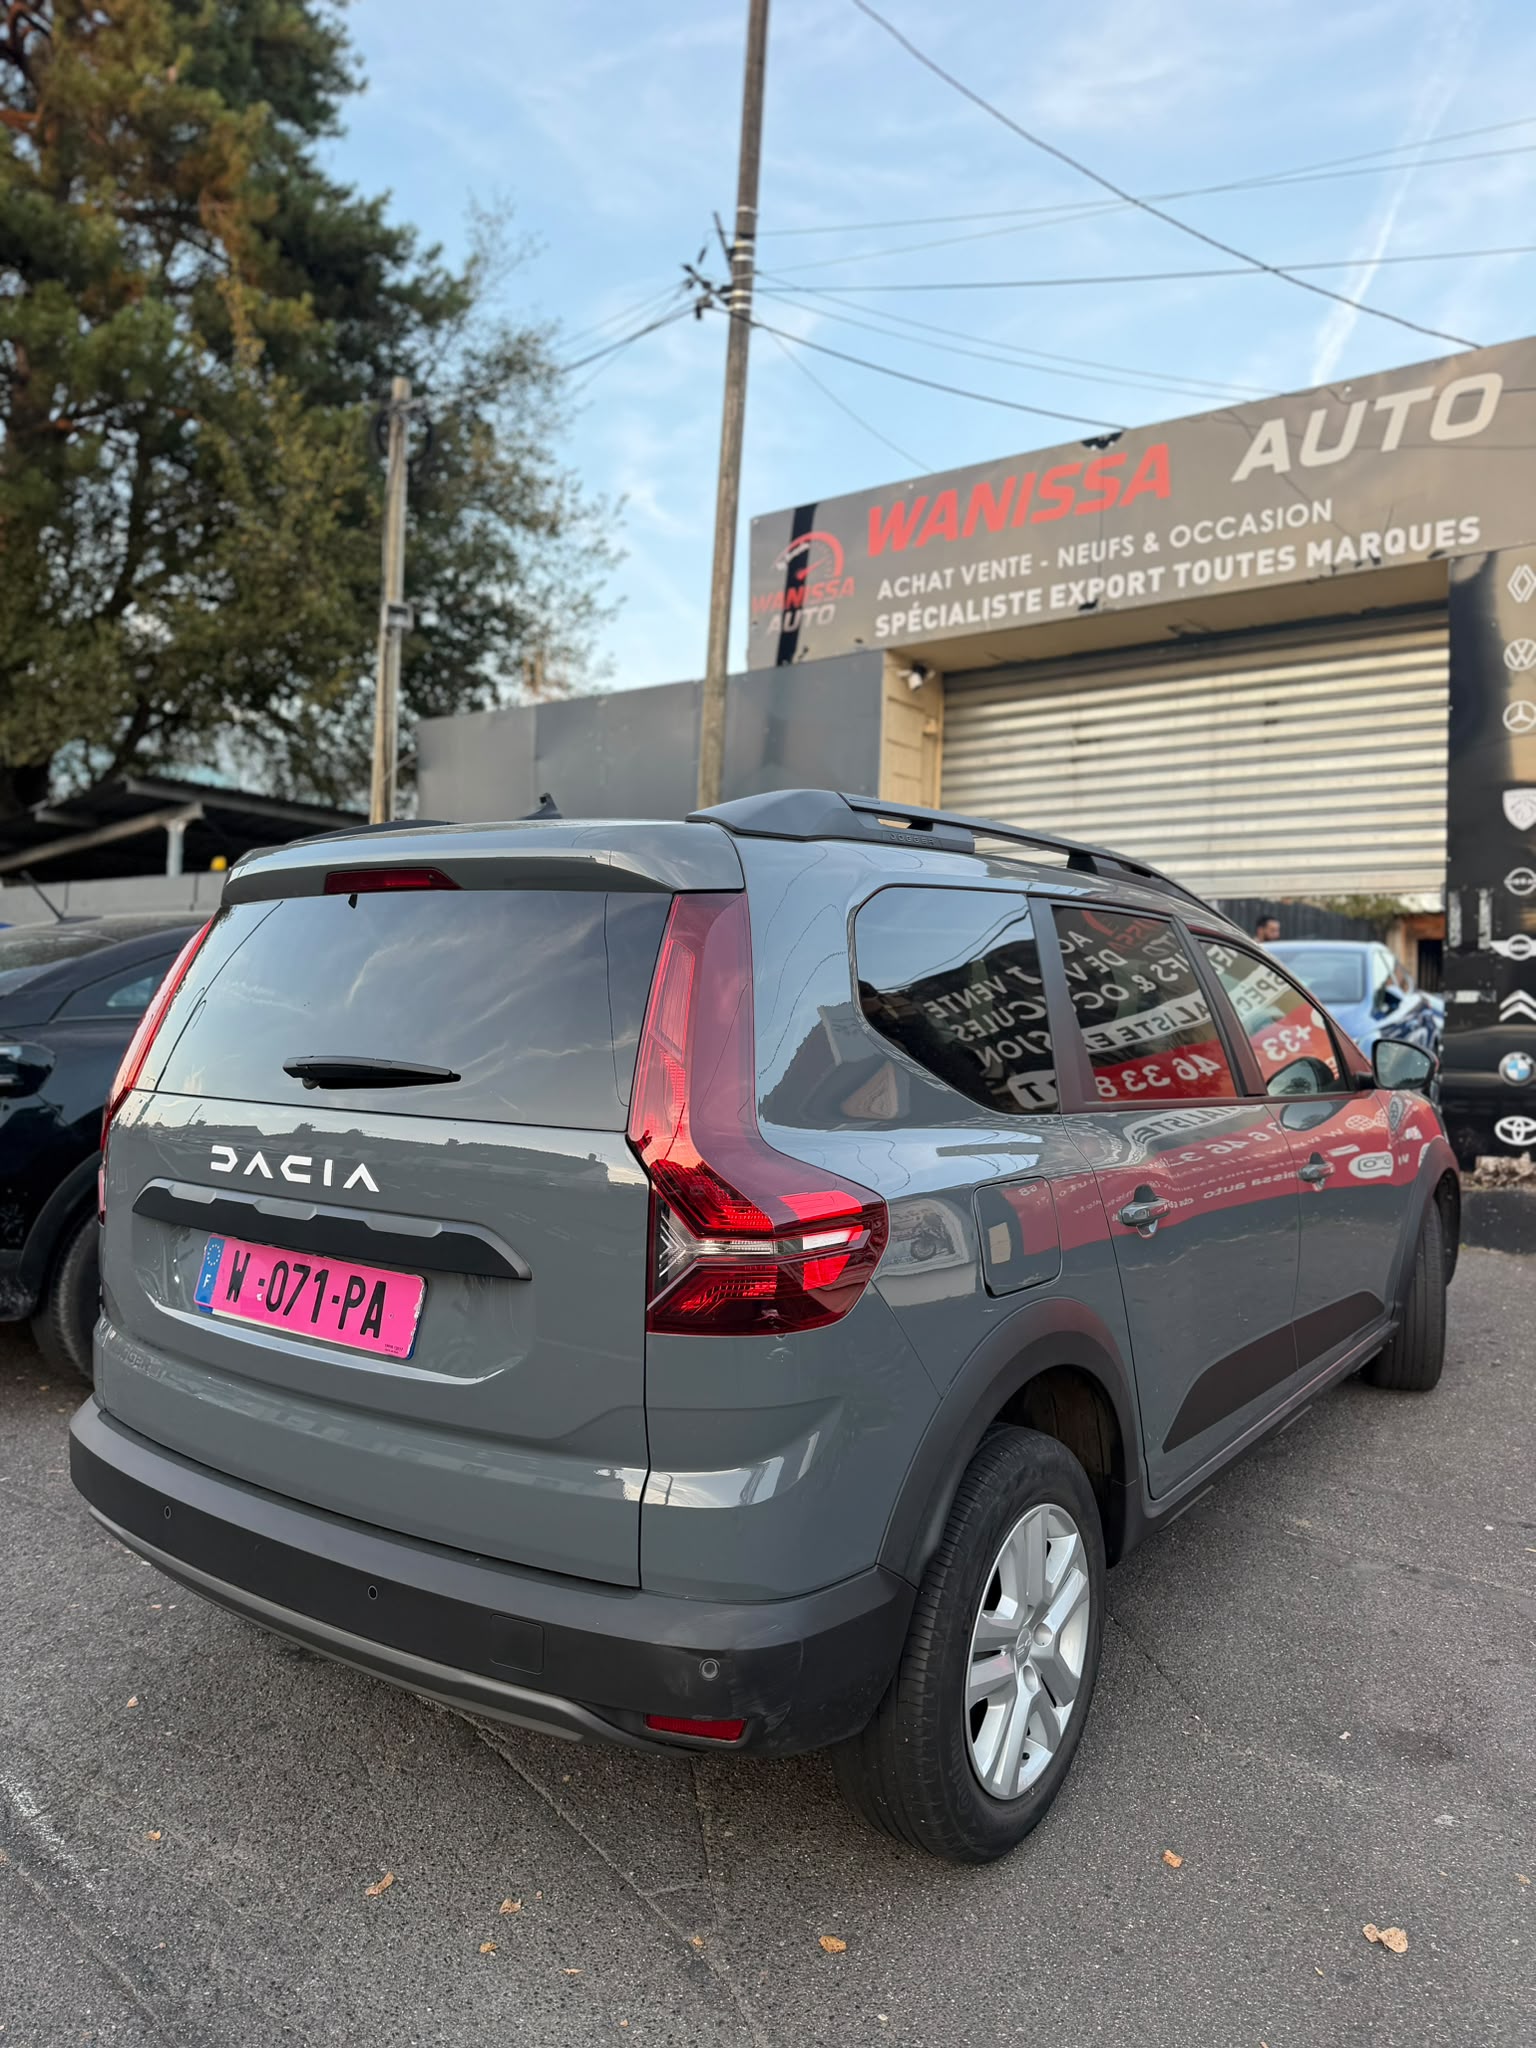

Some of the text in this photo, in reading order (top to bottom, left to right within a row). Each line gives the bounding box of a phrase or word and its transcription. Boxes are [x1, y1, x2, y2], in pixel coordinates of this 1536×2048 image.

[868, 373, 1503, 558] WANISSA AUTO
[877, 567, 955, 600] ACHAT
[960, 553, 1032, 586] VENTE
[1057, 534, 1135, 569] NEUFS
[1143, 531, 1160, 554] &
[1169, 498, 1332, 549] OCCASION
[751, 576, 855, 614] WANISSA
[874, 516, 1481, 638] SPÉCIALISTE EXPORT TOUTES MARQUES
[766, 604, 836, 635] AUTO
[210, 1145, 381, 1193] DACIA
[203, 1274, 211, 1288] F
